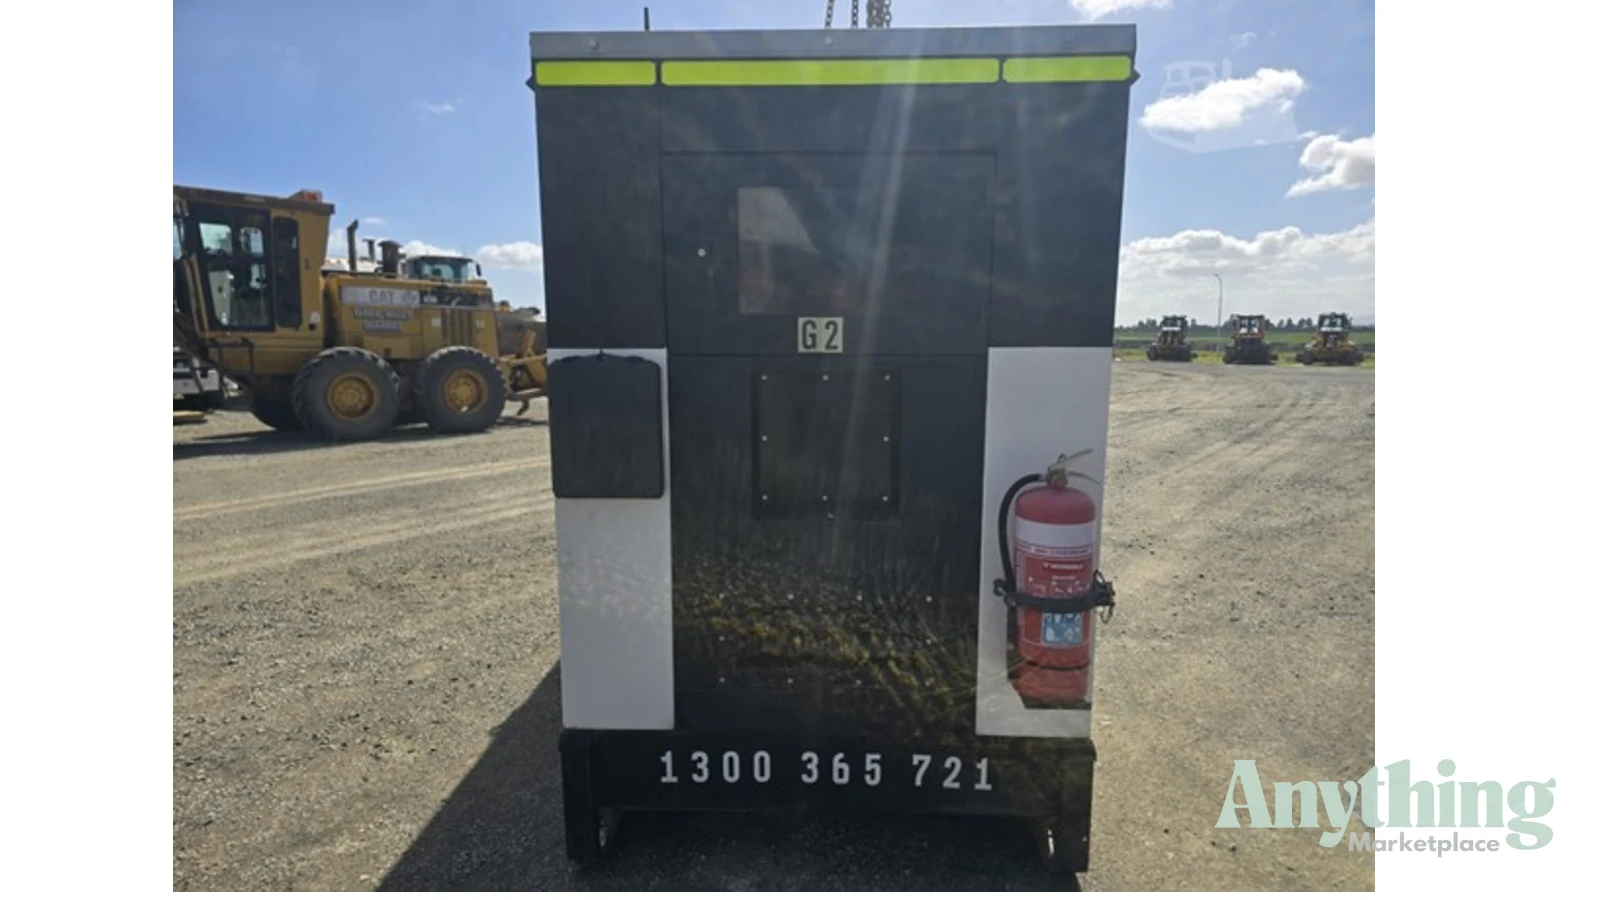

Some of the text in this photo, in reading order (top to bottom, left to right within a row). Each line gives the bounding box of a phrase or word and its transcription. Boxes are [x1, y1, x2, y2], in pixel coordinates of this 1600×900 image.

[801, 319, 840, 350] G2
[660, 750, 993, 791] 1300 365 721
